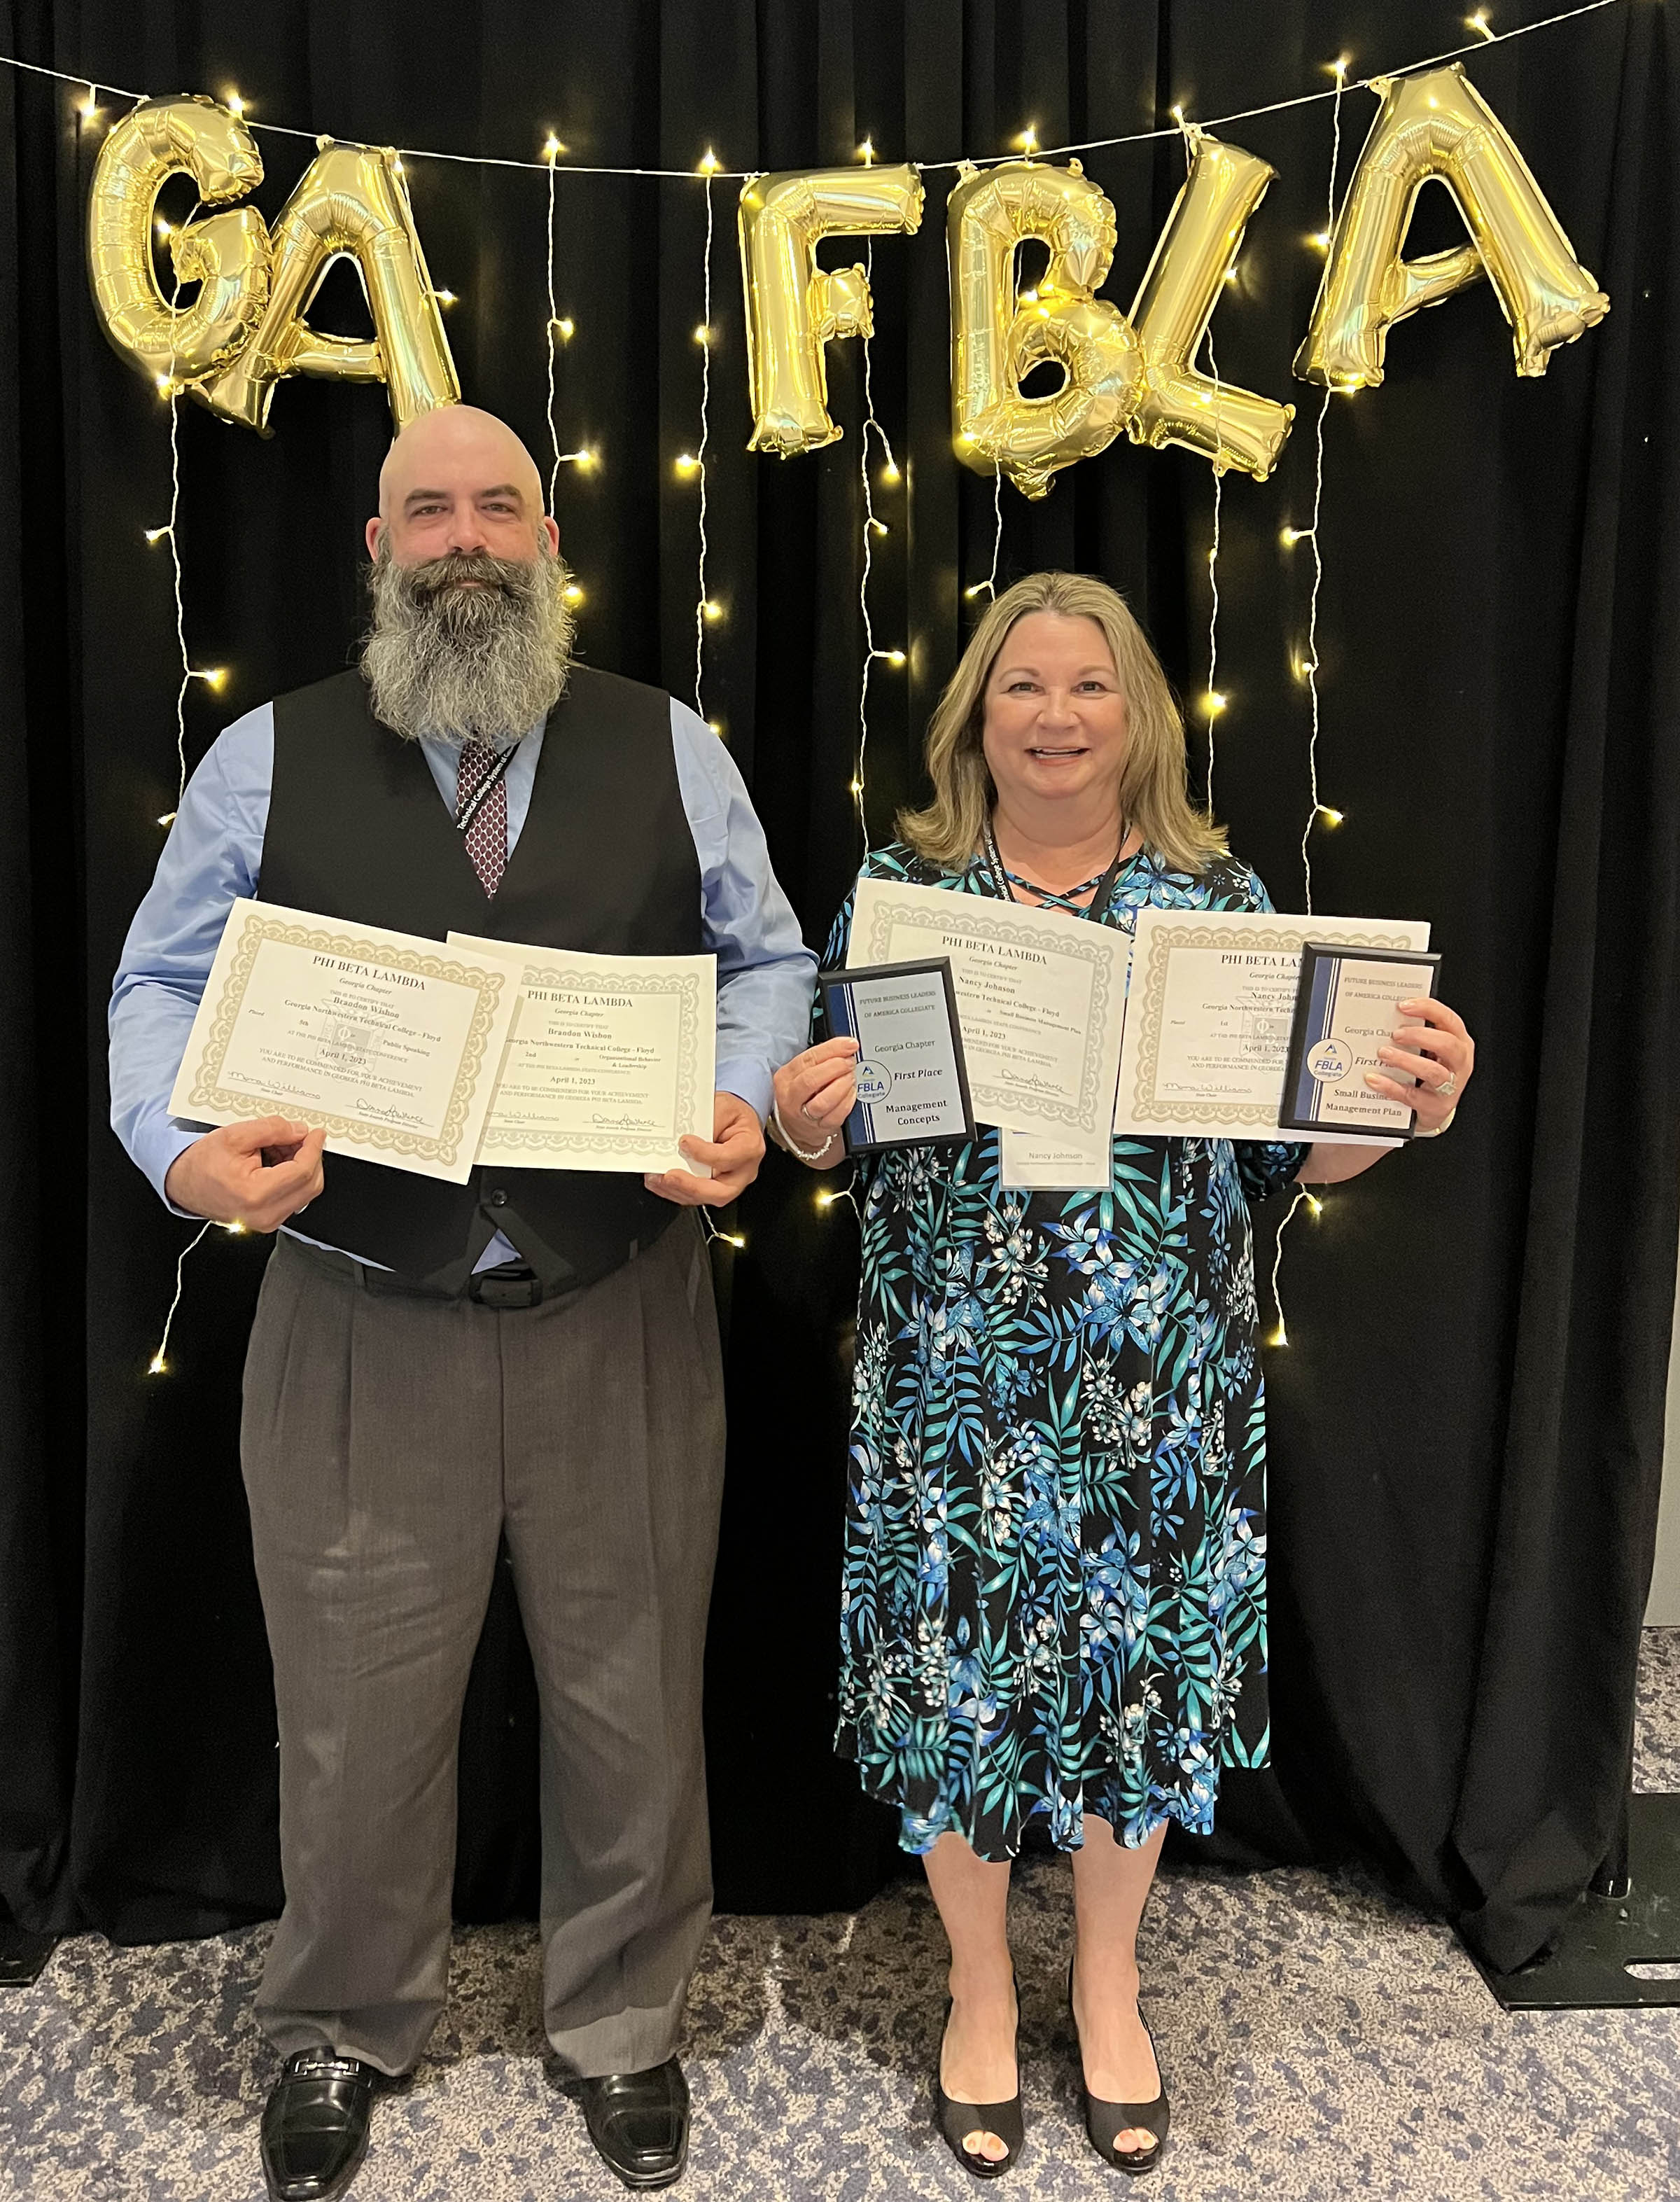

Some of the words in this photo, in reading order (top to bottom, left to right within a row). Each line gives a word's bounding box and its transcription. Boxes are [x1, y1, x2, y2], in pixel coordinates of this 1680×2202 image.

[87, 94, 461, 443] GA
[738, 62, 1610, 501] FBLA
[457, 800, 477, 829] Technical
[473, 781, 491, 801] College
[487, 763, 503, 781] System
[988, 845, 999, 865] System
[994, 865, 1004, 885] College
[942, 935, 962, 947] PHI
[965, 941, 995, 953] BETA
[997, 947, 1047, 963] LAMBDA
[969, 956, 992, 966] Georgia
[993, 961, 1017, 970] Chapter
[1221, 954, 1242, 964] PHI
[1245, 956, 1276, 966] BETA
[312, 956, 335, 968] PHI
[337, 962, 370, 976] BETA
[372, 970, 426, 989] LAMBDA
[1249, 971, 1274, 980] Georgia
[1276, 973, 1299, 982] Chapte
[339, 978, 365, 988] Georgia
[366, 984, 392, 994] Chapter
[958, 977, 981, 987] Nancy
[983, 982, 1015, 993] Johnson
[527, 990, 547, 1000] PHI
[550, 991, 580, 1003] BETA
[583, 994, 633, 1008] LAMBDA
[859, 996, 881, 1005] FUTURE
[883, 993, 909, 1001] BUSINESS
[910, 989, 935, 998] LEADERS
[1252, 991, 1274, 1001] Nancy
[332, 997, 368, 1010] Brandon
[370, 1006, 400, 1017] Wishon
[873, 1008, 899, 1017] AMERICA
[900, 1004, 934, 1013] COLLEGIATE
[955, 990, 979, 998] western
[982, 995, 1012, 1005] Technical
[1012, 1002, 1036, 1011] College
[1042, 1008, 1059, 1017] Floyd
[1229, 1004, 1273, 1012] Northwestern
[554, 1007, 578, 1016] Georgia
[580, 1010, 603, 1018] Chapter
[284, 999, 312, 1010] Georgia
[312, 1006, 357, 1022] Northwestern
[358, 1017, 391, 1029] Technical
[391, 1025, 416, 1036] College
[421, 1032, 442, 1041] Floyd
[548, 1027, 581, 1038] Brandon
[962, 1026, 980, 1034] April
[1344, 1026, 1373, 1037] Georgia
[382, 1040, 401, 1049] Public
[402, 1045, 430, 1057] Speaking
[530, 1038, 573, 1048] Northwestern
[575, 1042, 606, 1051] Technical
[607, 1045, 630, 1053] College
[874, 1043, 903, 1053] Georgia
[905, 1039, 935, 1050] Chapter
[1243, 1044, 1261, 1052] April
[318, 1049, 339, 1058] April
[349, 1056, 366, 1064] 2023
[1354, 1057, 1378, 1066] First
[1315, 1060, 1342, 1071] FBLA
[894, 1071, 915, 1080] First
[917, 1068, 942, 1077] Place
[1313, 1069, 1342, 1078] Collegiate
[857, 1081, 884, 1092] FBLA
[1334, 1088, 1358, 1098] Small
[886, 1099, 946, 1114] Management
[1325, 1103, 1380, 1115] Management
[1382, 1108, 1401, 1116] Plan
[897, 1113, 939, 1127] Concepts
